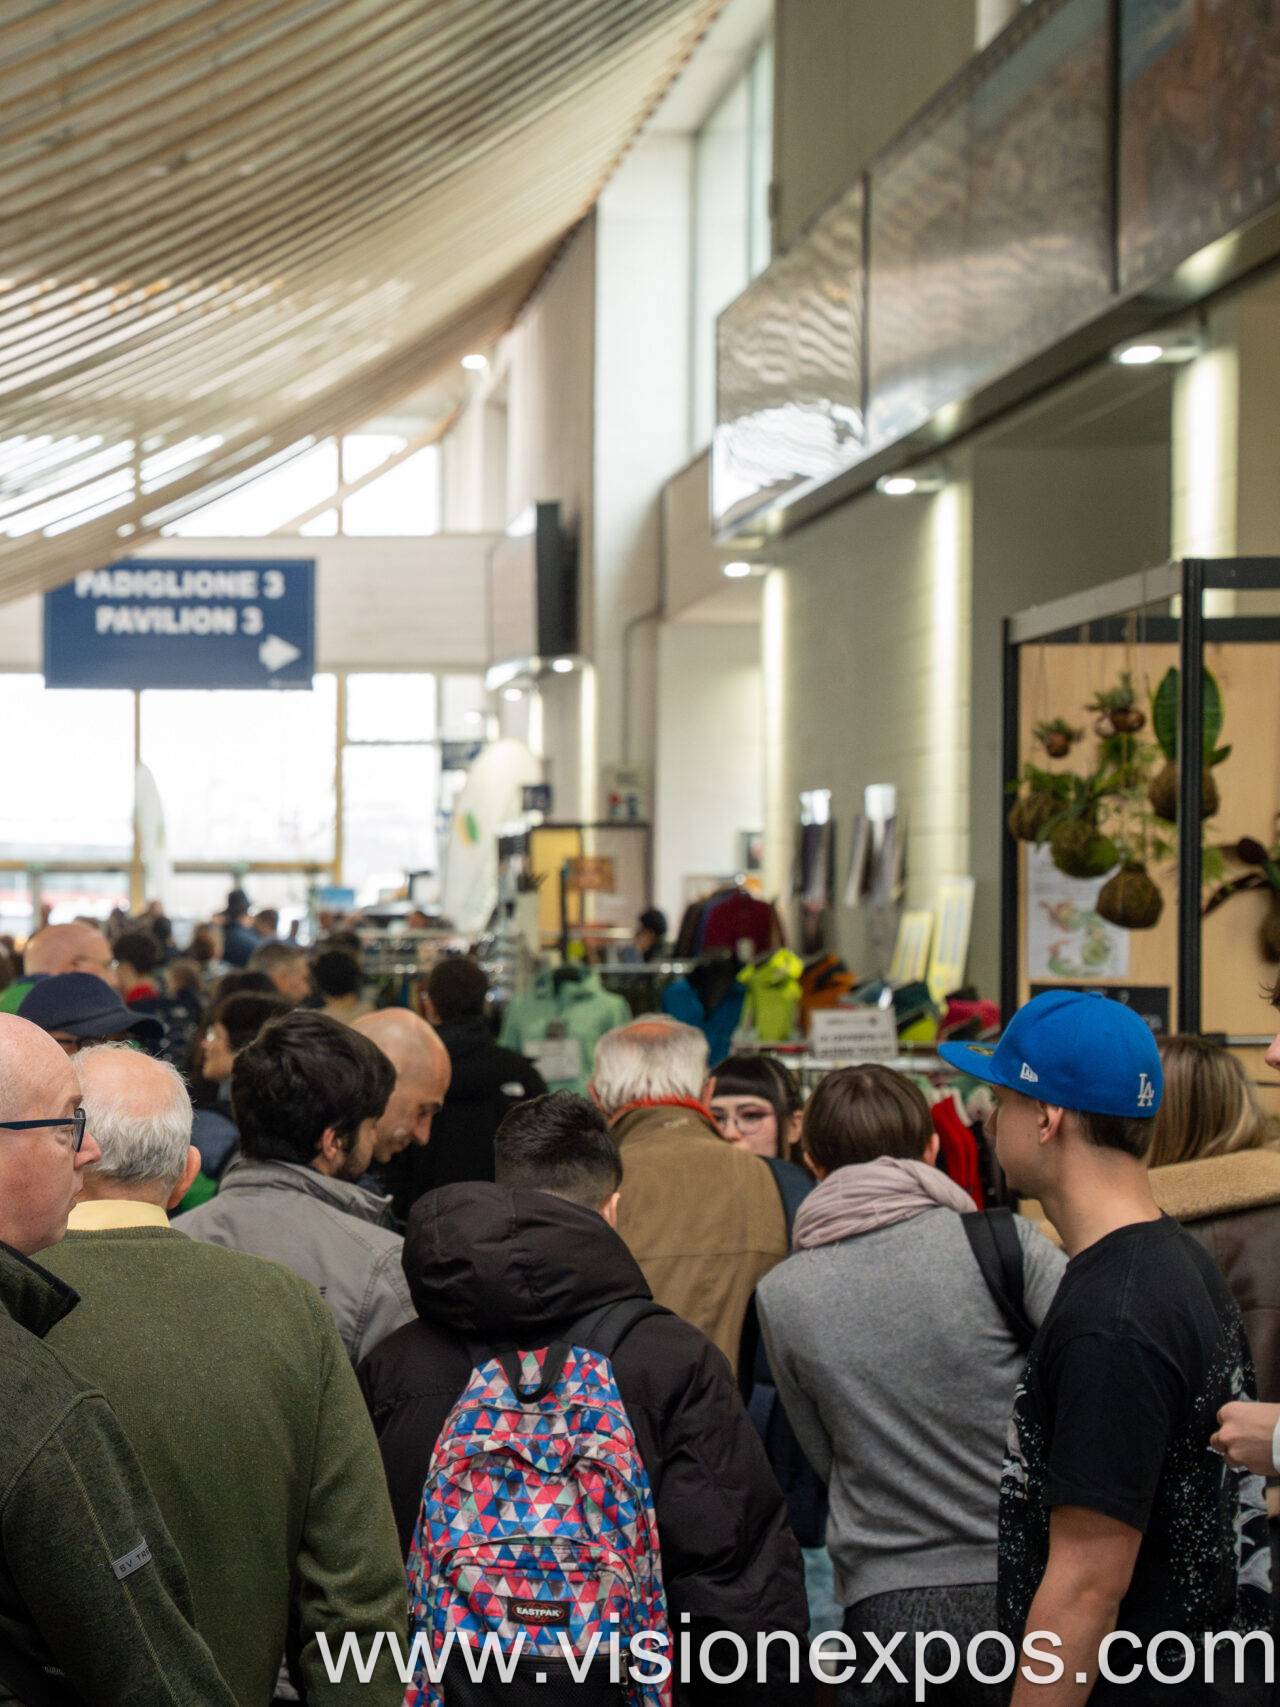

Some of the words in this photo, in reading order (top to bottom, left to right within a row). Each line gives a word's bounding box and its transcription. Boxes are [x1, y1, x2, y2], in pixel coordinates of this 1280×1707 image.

[74, 568, 259, 600] PADIGLIONE
[263, 569, 286, 600] 3
[94, 605, 238, 635] PAVILION
[241, 605, 264, 635] 3
[516, 1606, 560, 1618] EASTPAK
